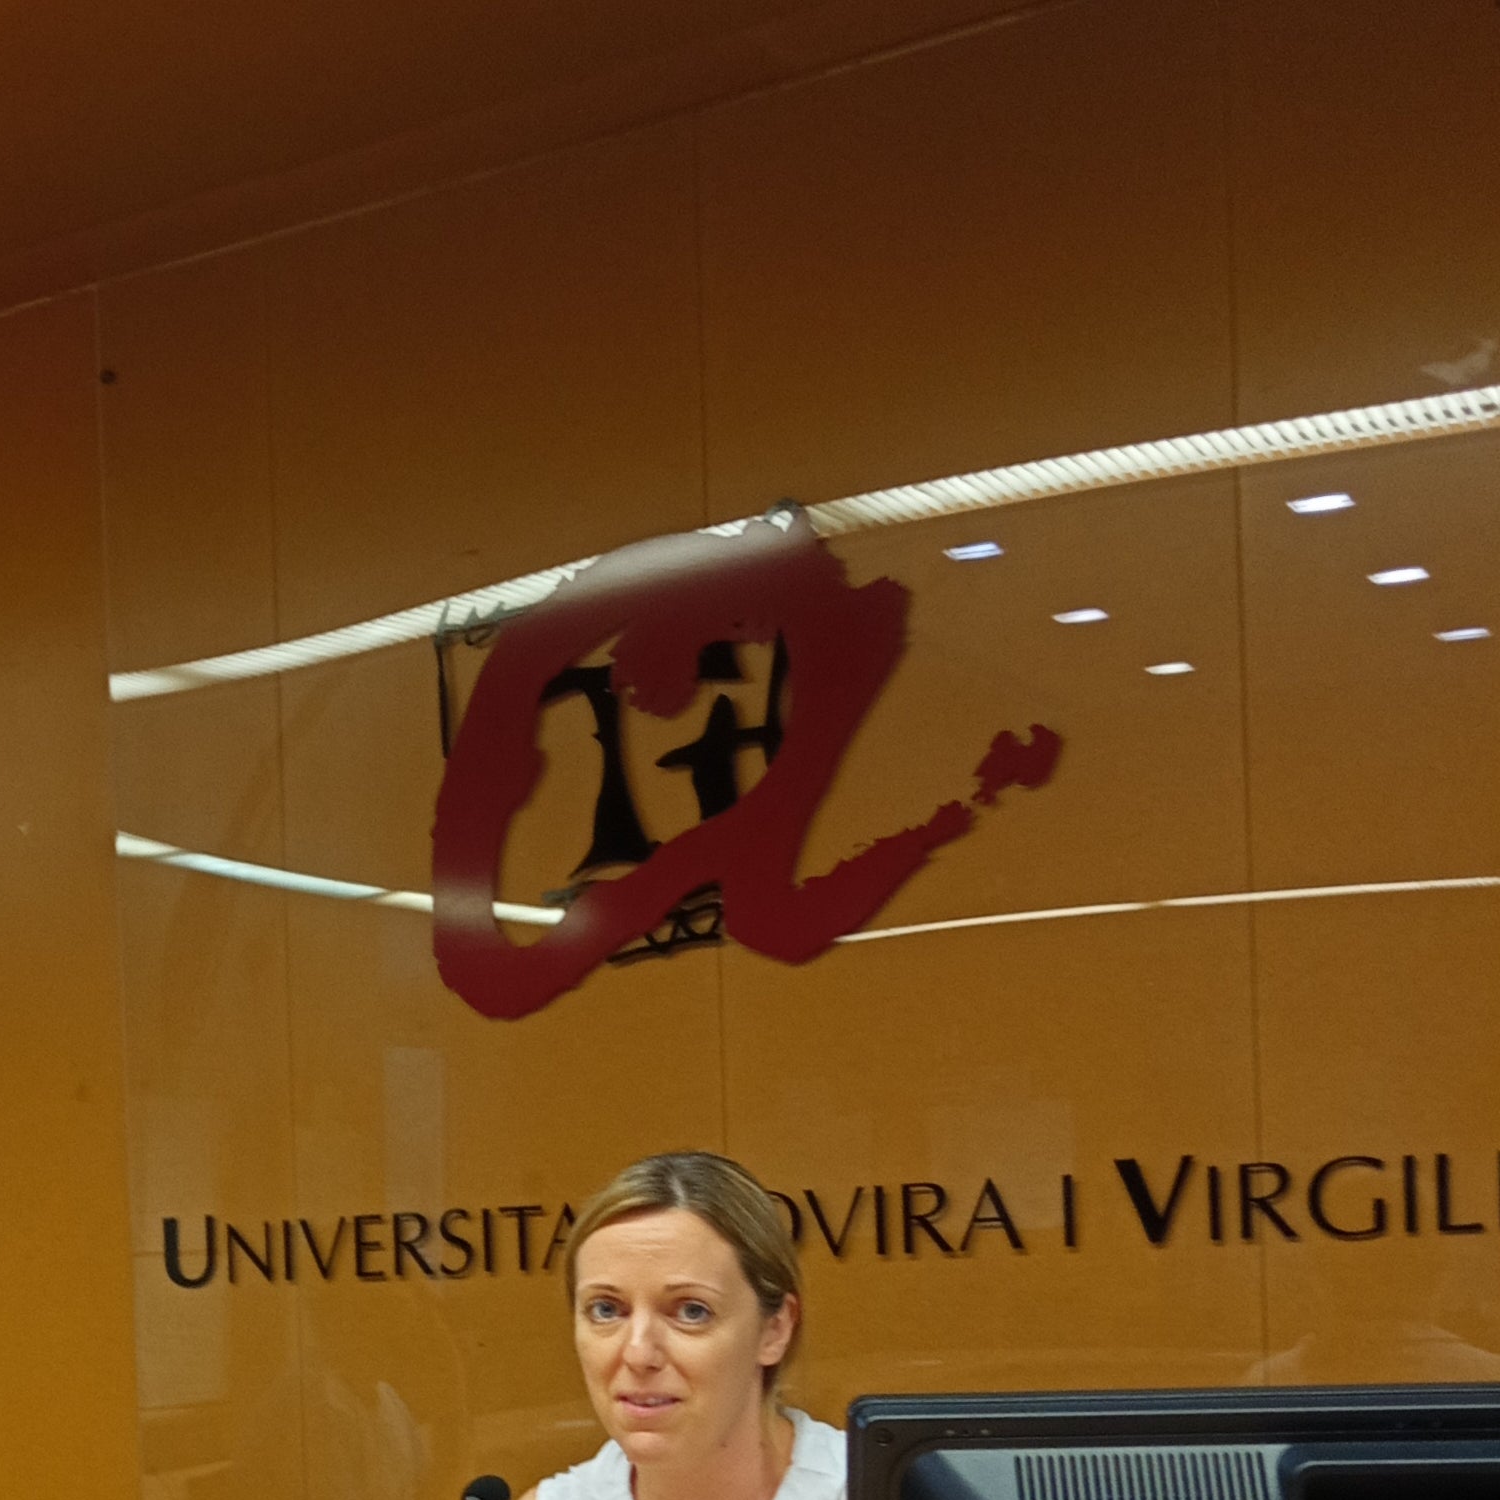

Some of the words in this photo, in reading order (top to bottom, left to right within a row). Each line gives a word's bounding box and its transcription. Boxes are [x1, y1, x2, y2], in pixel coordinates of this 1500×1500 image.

[161, 1202, 578, 1290] UNIVERSITA
[1061, 1173, 1078, 1248] I
[1113, 1152, 1500, 1245] VIRGIL
